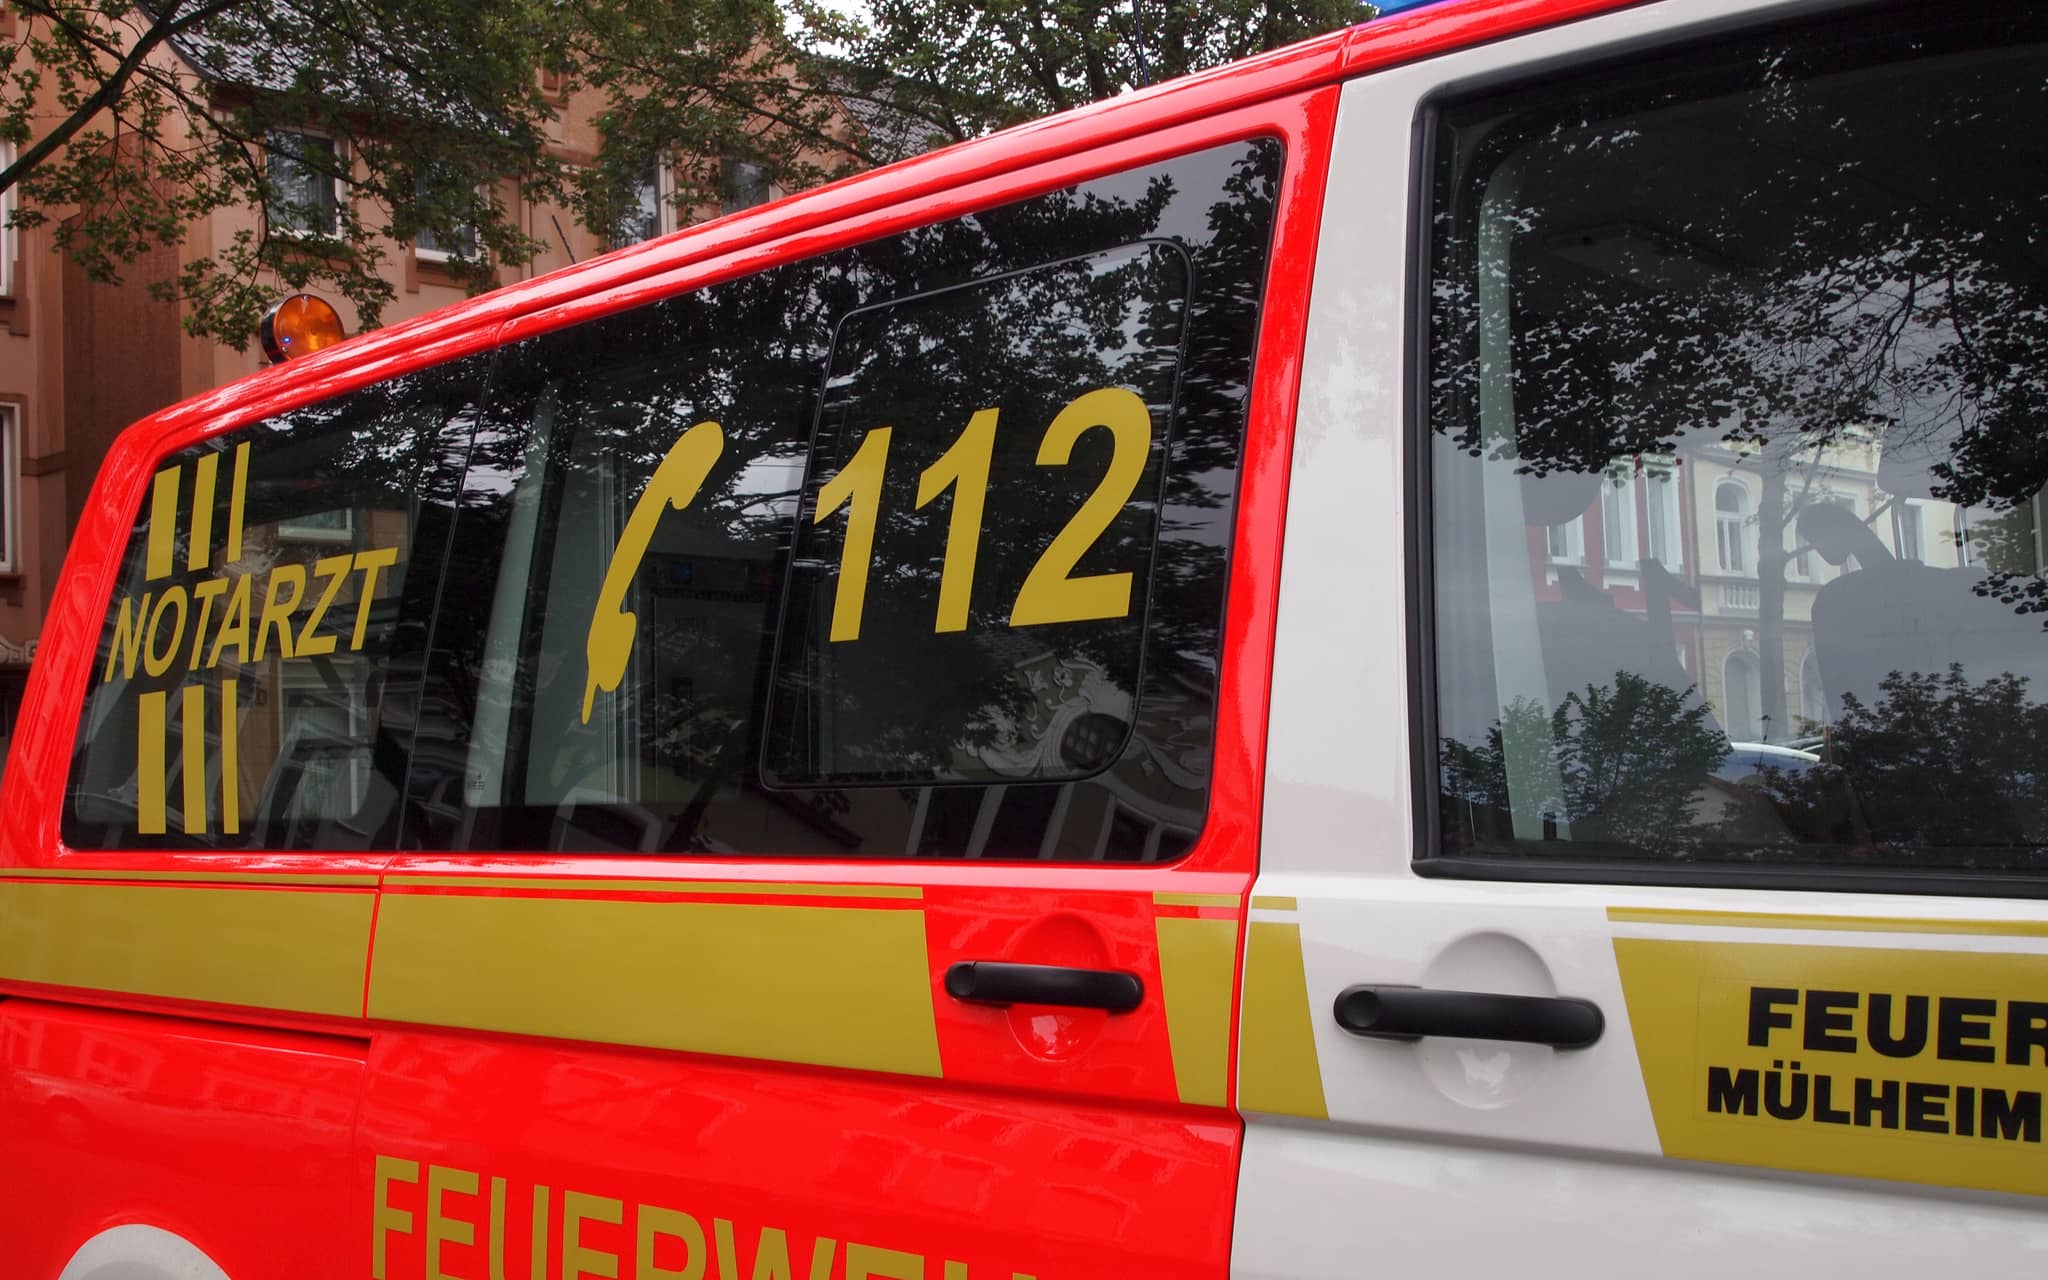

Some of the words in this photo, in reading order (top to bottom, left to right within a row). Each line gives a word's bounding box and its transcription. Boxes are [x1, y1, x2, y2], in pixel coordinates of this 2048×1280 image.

[813, 387, 1152, 642] 112
[104, 547, 398, 683] NOTARZT
[1747, 986, 2048, 1067] FEUER
[1707, 1059, 2042, 1143] MÜLHEIM
[371, 1154, 1037, 1280] FEUER
